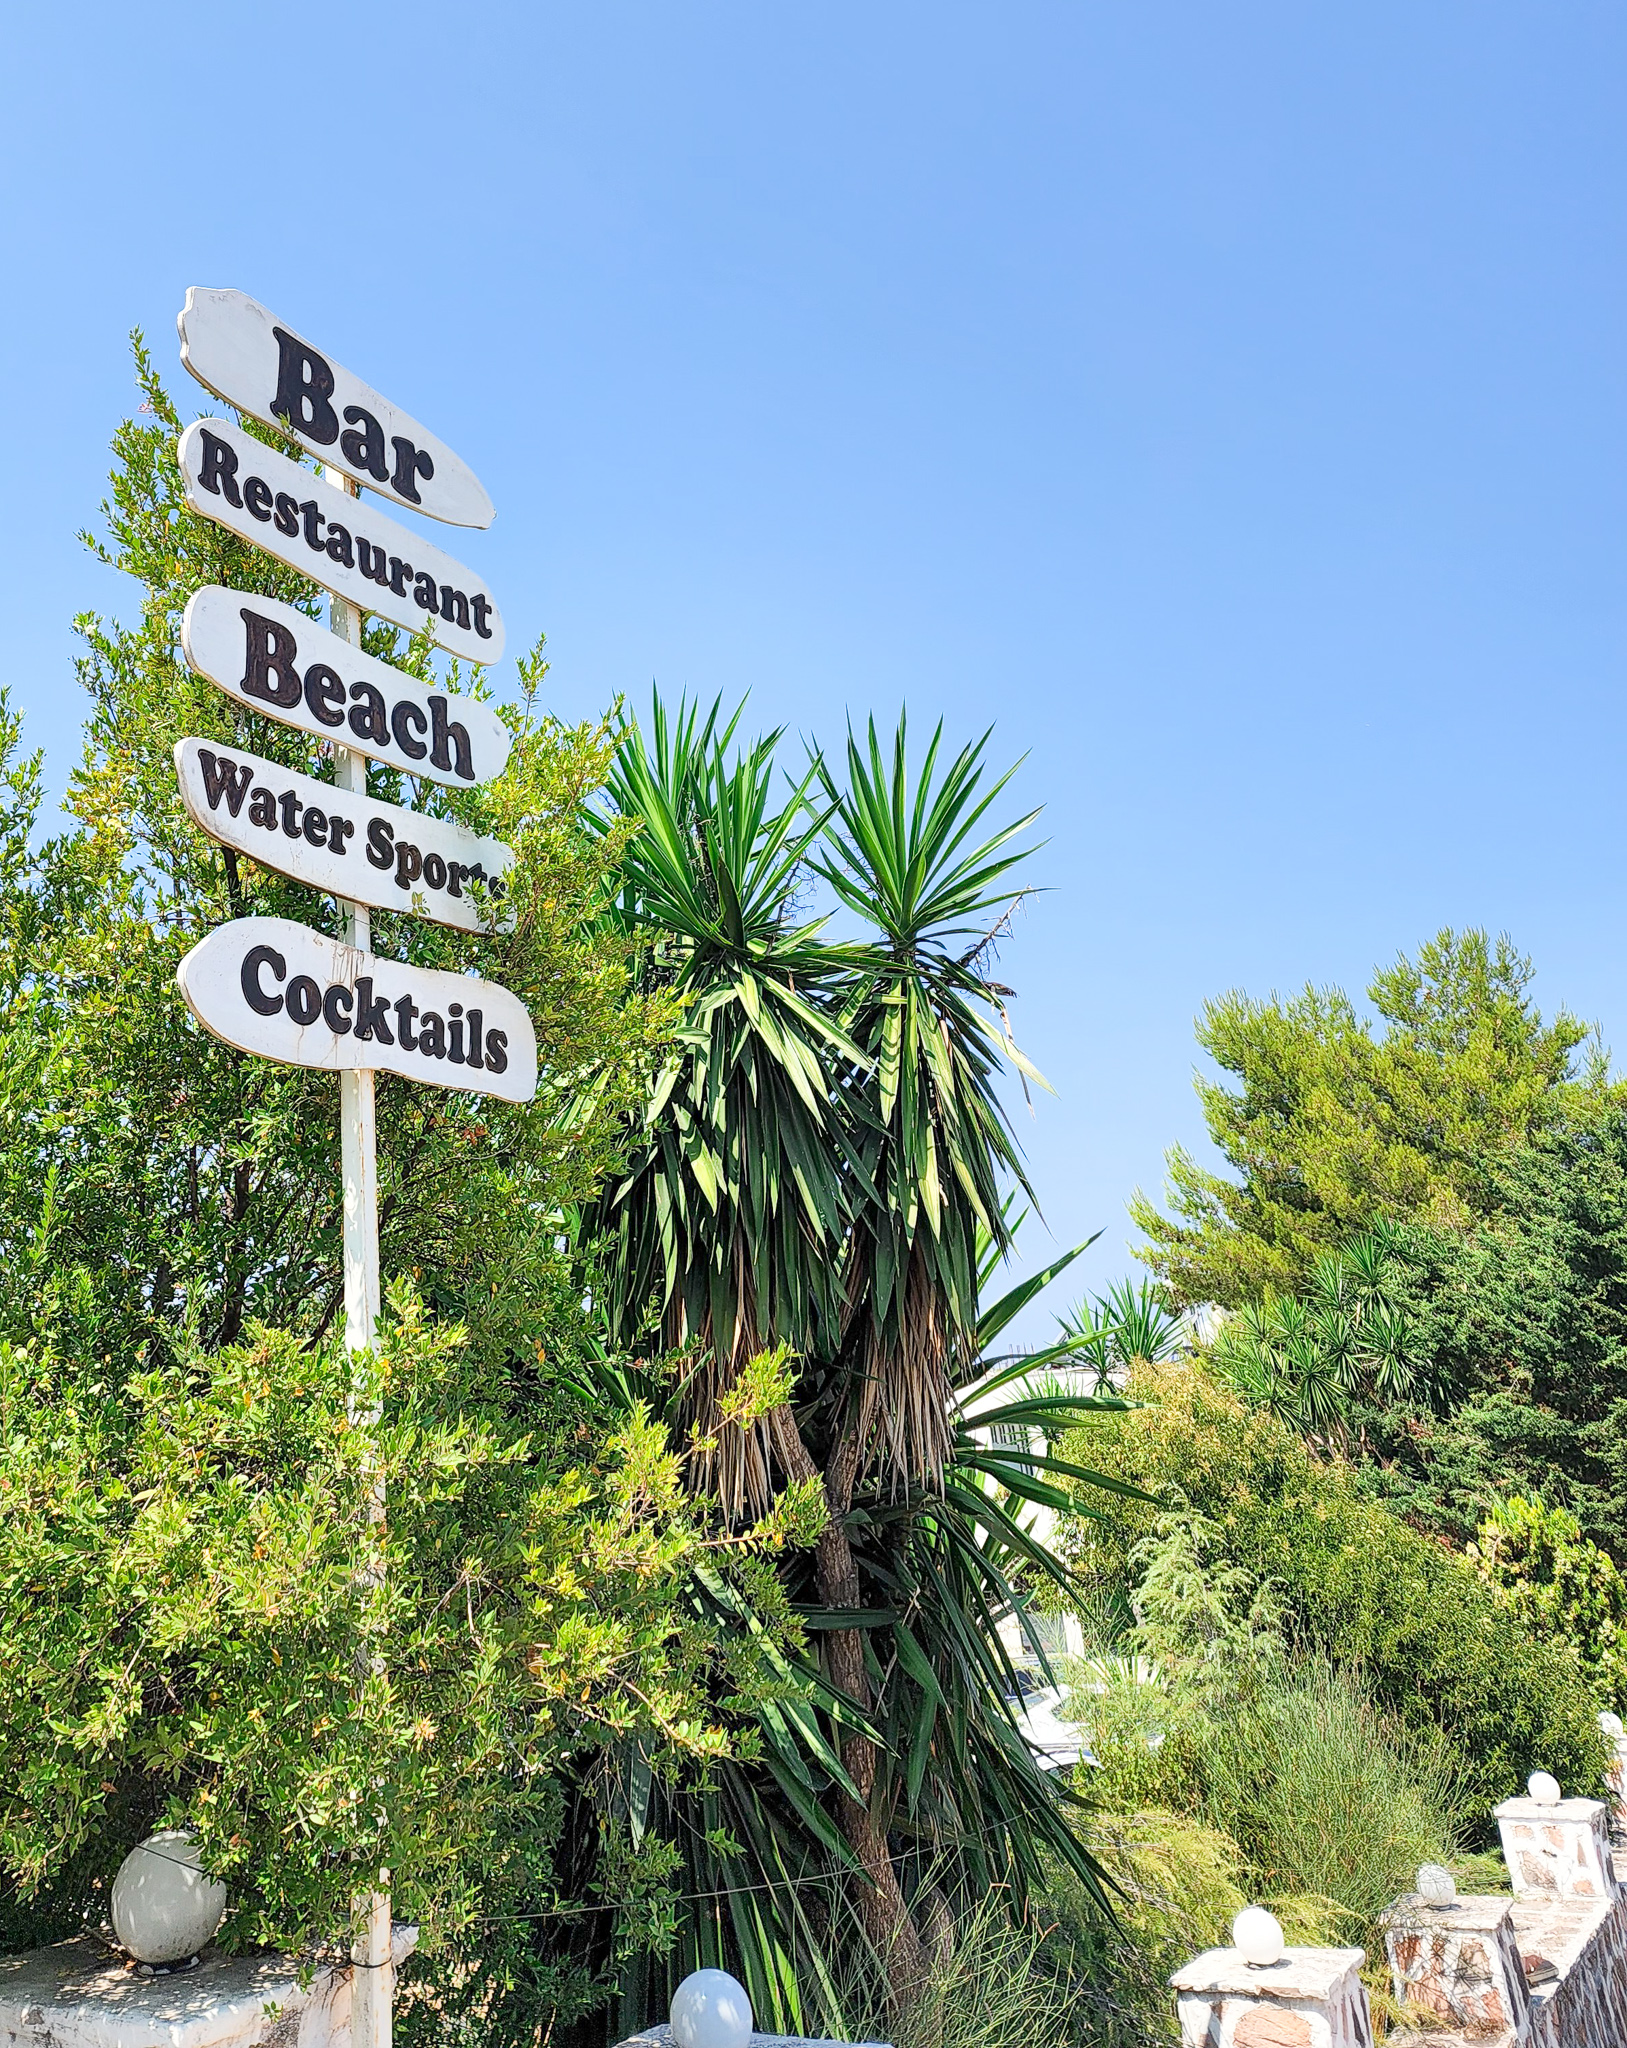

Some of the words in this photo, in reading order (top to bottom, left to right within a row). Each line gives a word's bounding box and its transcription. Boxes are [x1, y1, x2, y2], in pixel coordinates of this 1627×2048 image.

[270, 326, 434, 504] Bar
[198, 428, 493, 639] Restaurant
[240, 608, 475, 780] Beach
[197, 748, 355, 855] Water
[241, 944, 508, 1074] Cocktails
